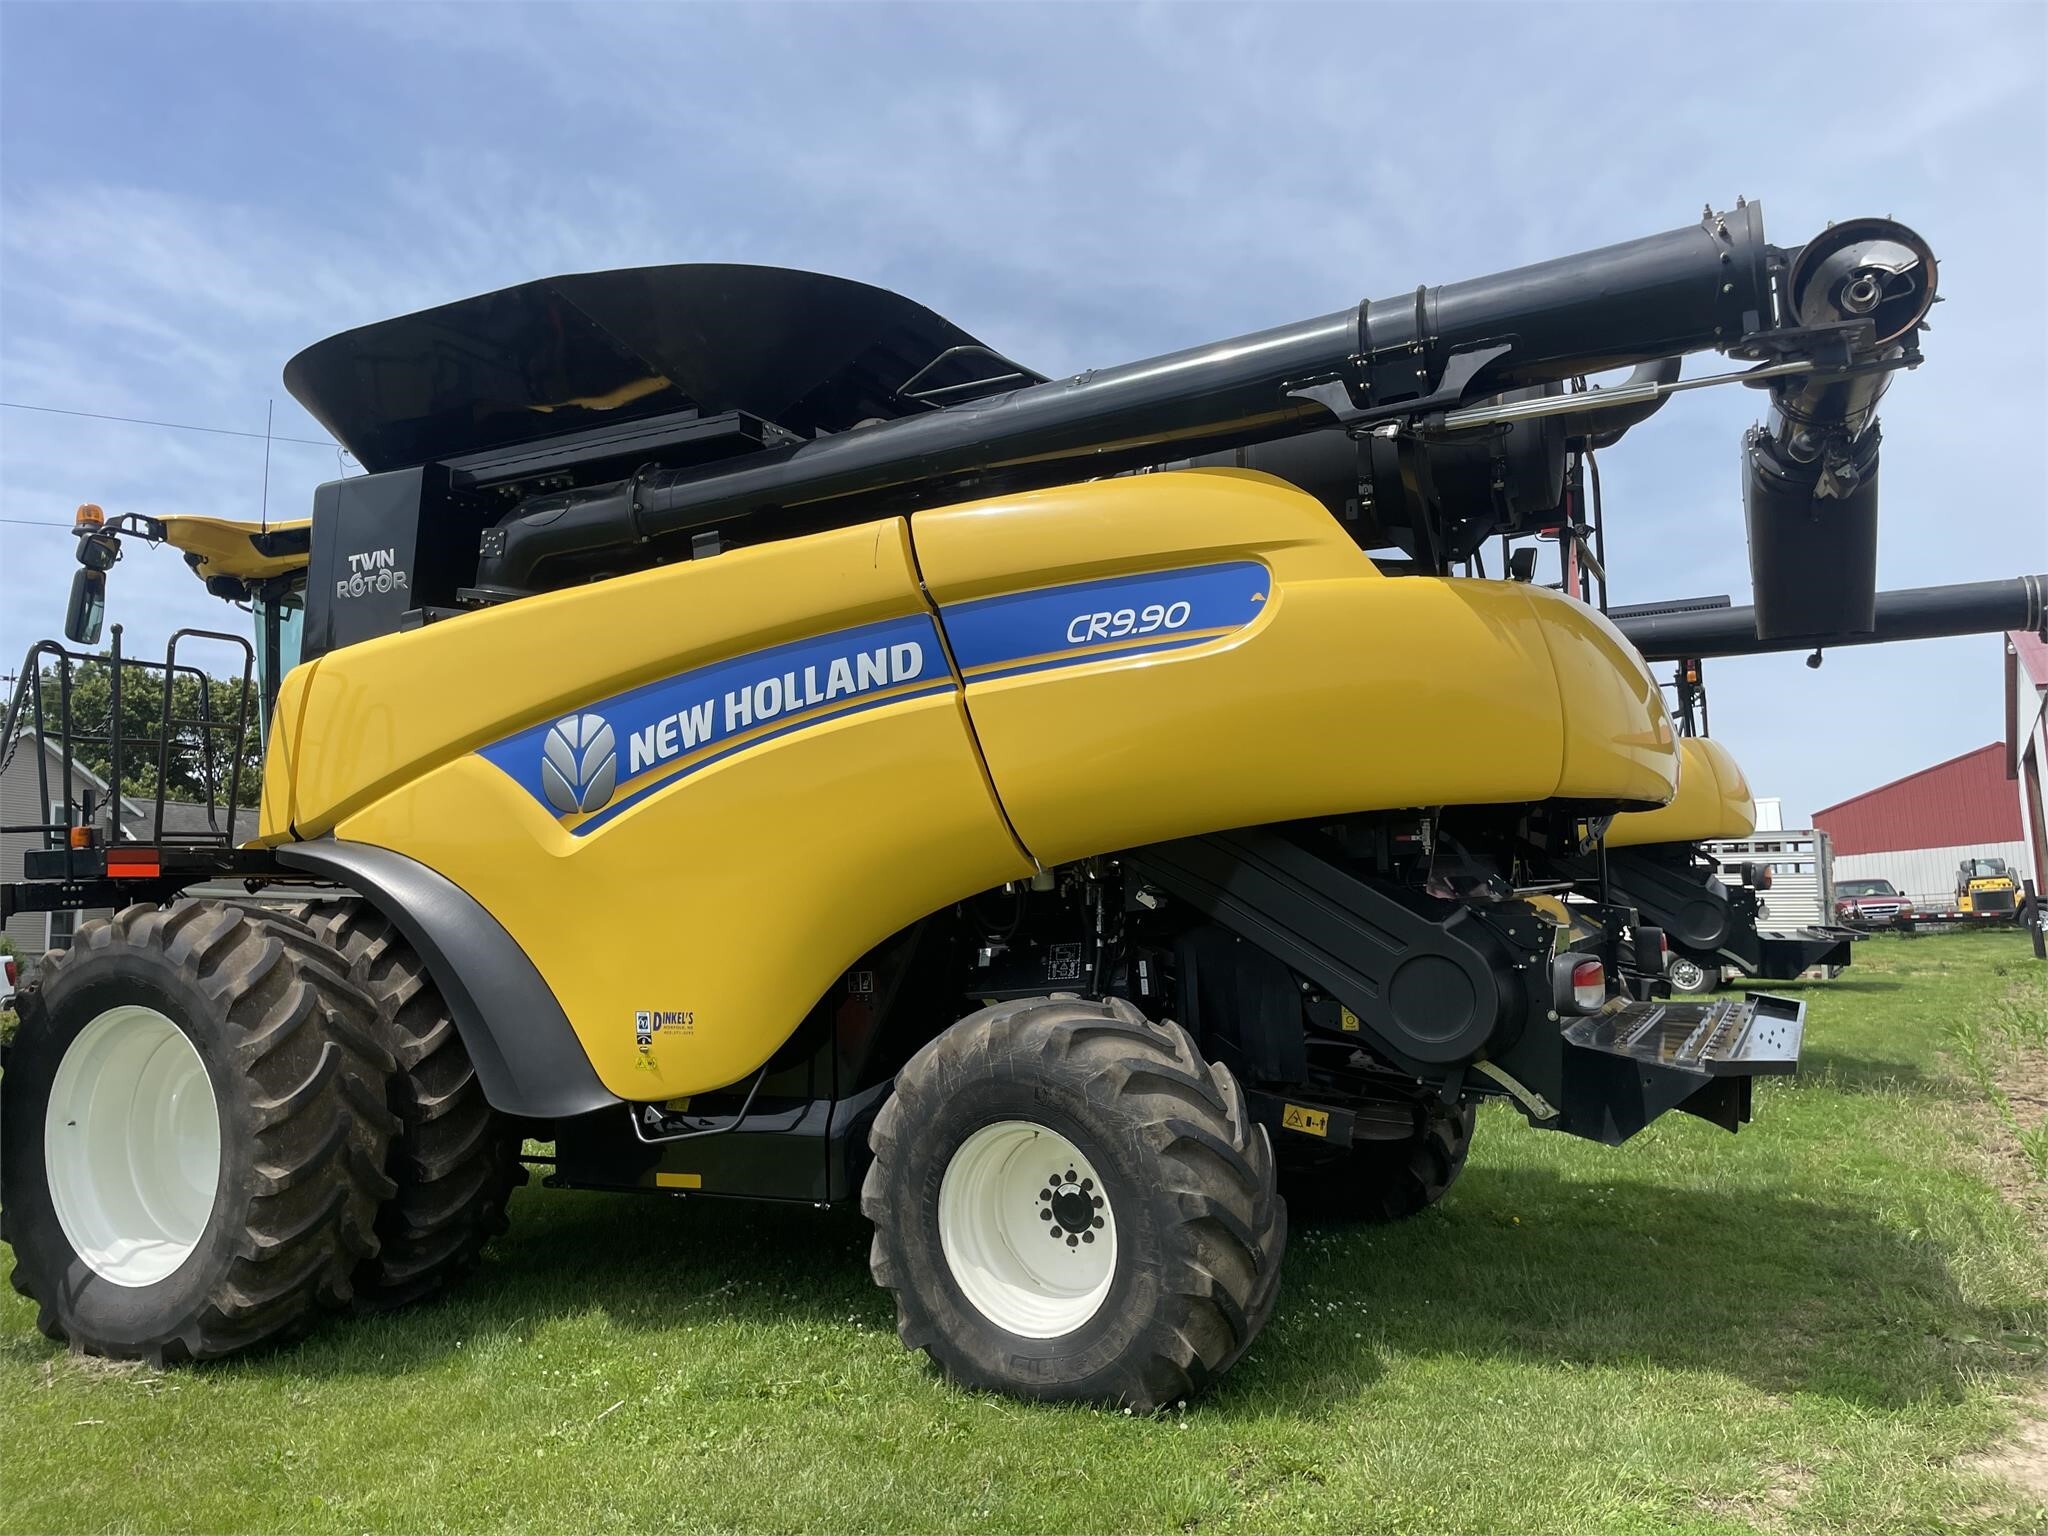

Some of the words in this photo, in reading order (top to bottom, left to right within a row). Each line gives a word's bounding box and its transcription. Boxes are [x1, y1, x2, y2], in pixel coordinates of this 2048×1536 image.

[348, 548, 395, 573] TWIN
[336, 568, 409, 599] ROTOR
[1067, 601, 1191, 643] CR9.90
[630, 699, 715, 774] NEW
[724, 641, 923, 732] HOLLAND
[653, 1011, 694, 1031] DINKEL'S
